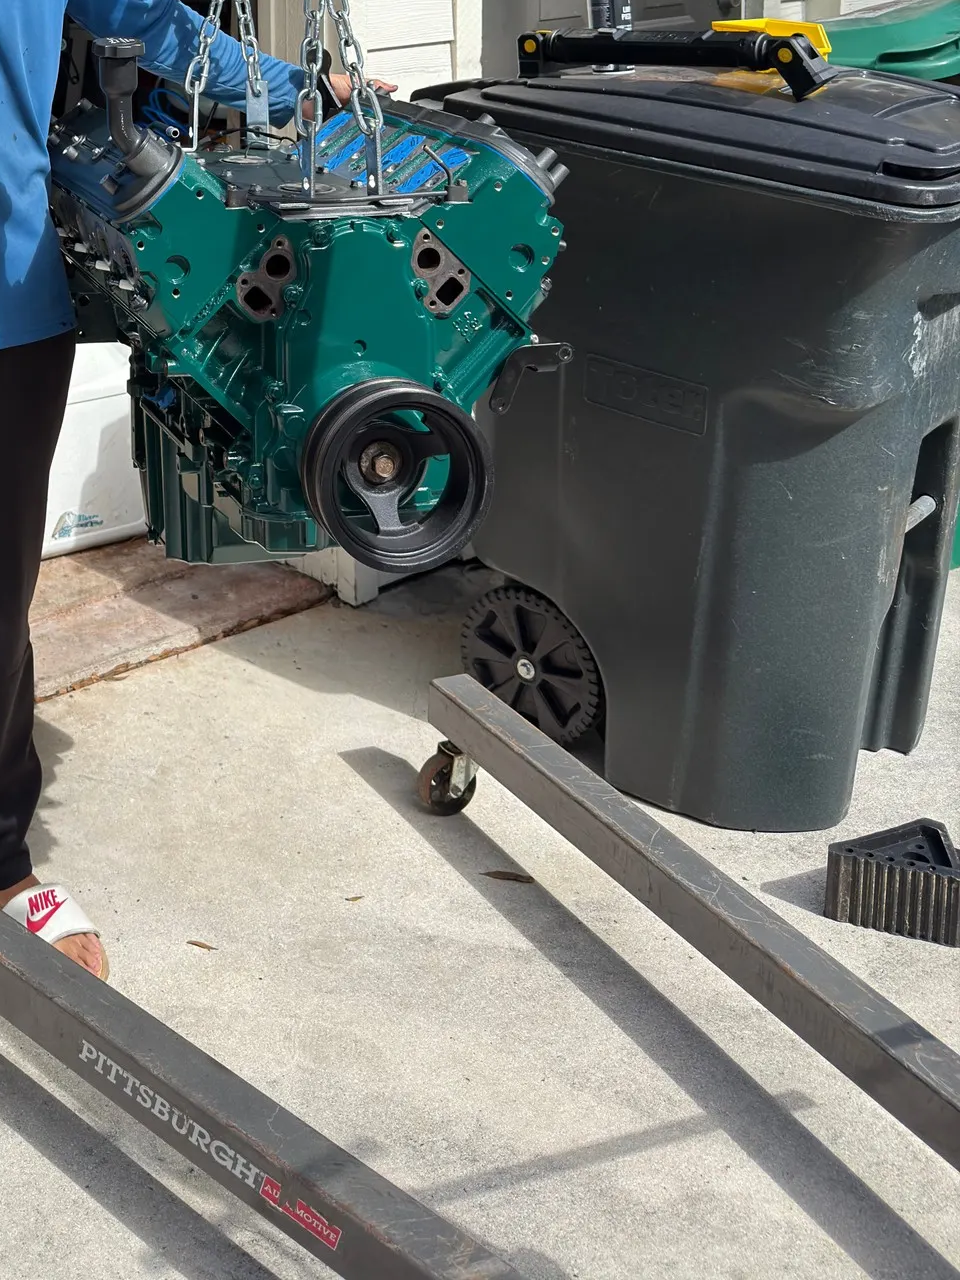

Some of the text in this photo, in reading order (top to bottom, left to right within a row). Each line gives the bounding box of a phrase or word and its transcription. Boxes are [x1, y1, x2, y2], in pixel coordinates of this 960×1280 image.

[28, 889, 60, 917] NIKE
[78, 1039, 264, 1190] PITTSBURGH
[264, 1184, 337, 1242] AUMOTIVE
